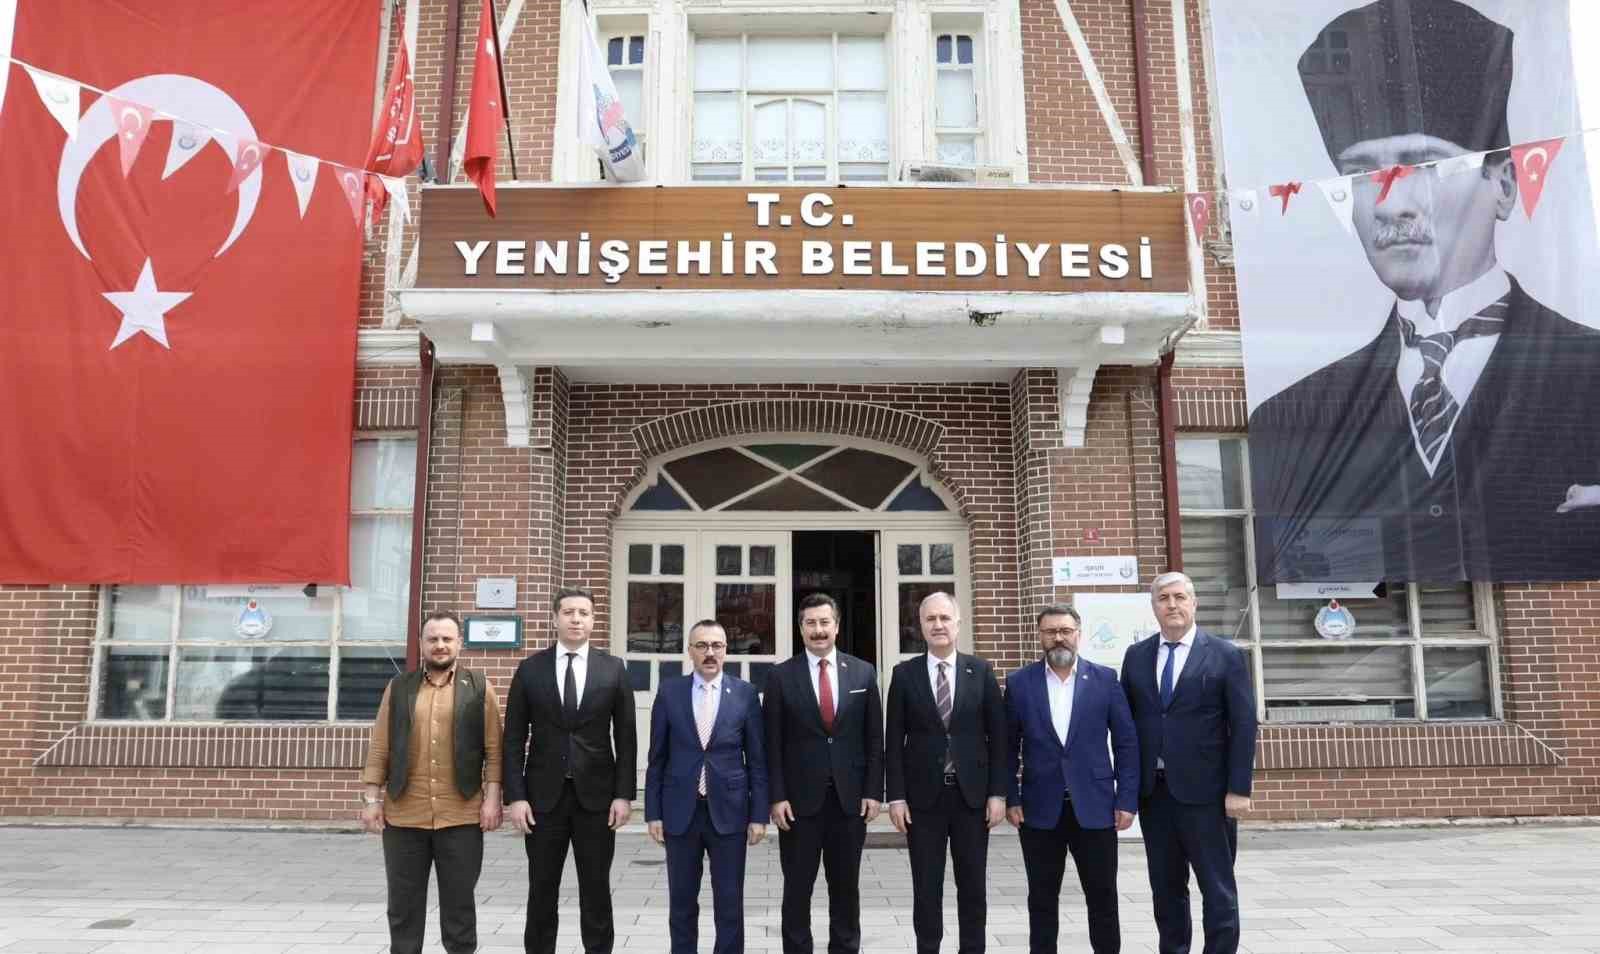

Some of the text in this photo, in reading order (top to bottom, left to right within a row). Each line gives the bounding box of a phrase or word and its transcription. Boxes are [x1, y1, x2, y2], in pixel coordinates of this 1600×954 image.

[747, 192, 855, 227] T.C.
[454, 232, 1154, 283] YENİŞEHİR BELEDİYESİ
